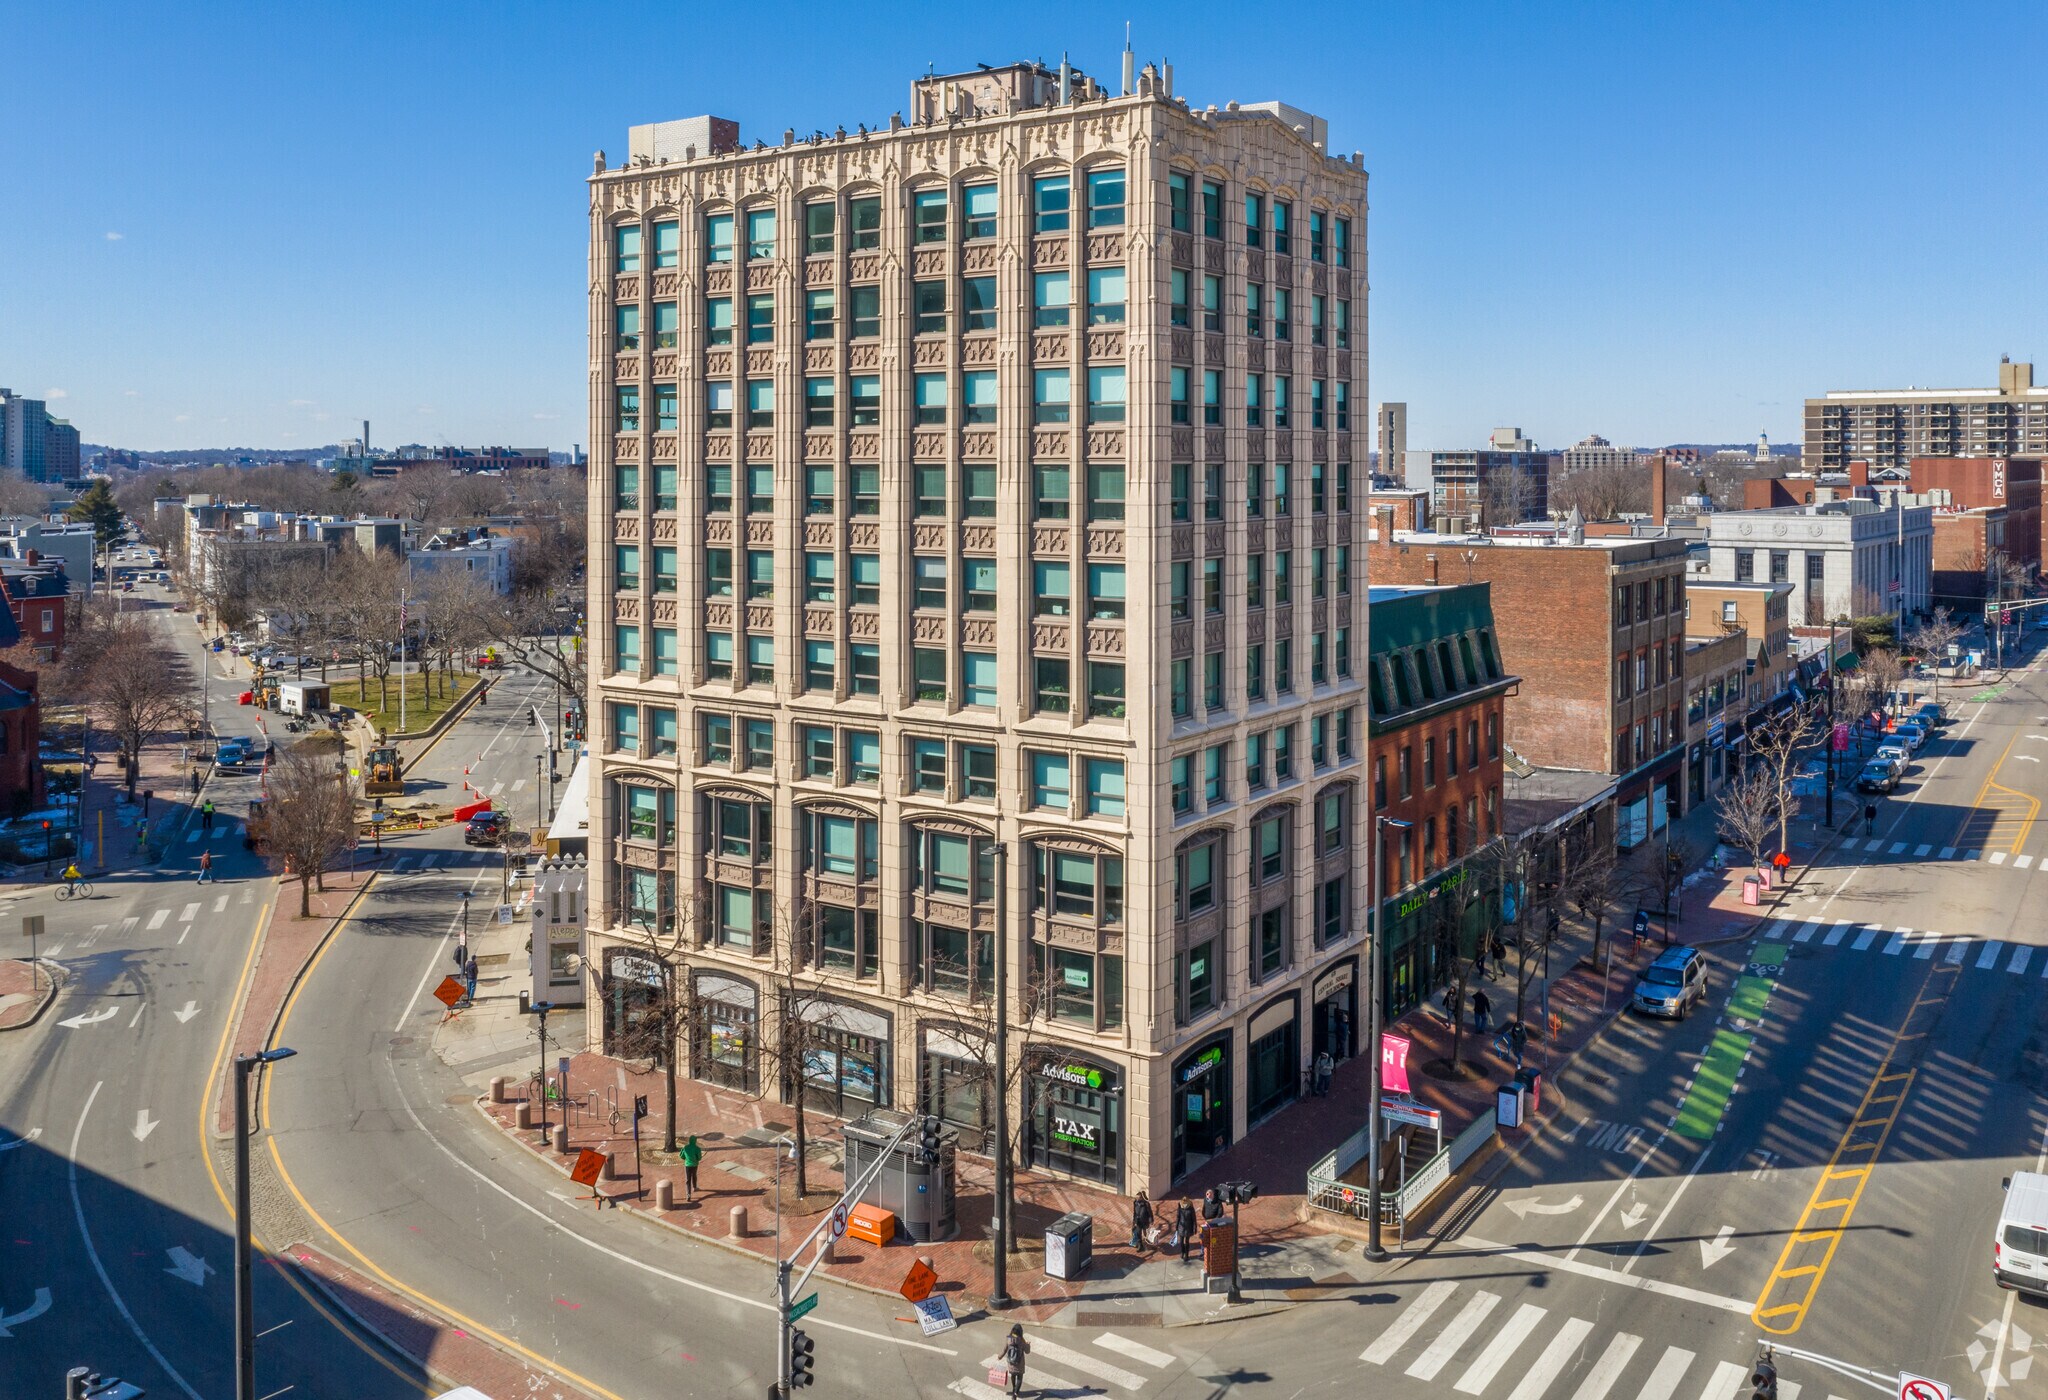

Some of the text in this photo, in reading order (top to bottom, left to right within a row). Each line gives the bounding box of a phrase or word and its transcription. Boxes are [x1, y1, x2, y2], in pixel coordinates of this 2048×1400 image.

[1994, 462, 2003, 496] YMCA
[1400, 869, 1468, 918] DAILY TABLE
[550, 927, 580, 939] Aleppo
[1317, 972, 1349, 996] CENTRAL SQUARE
[1383, 1048, 1405, 1069] Hi
[1041, 1063, 1087, 1085] Advisors
[1187, 1059, 1213, 1081] Advisors
[1392, 1103, 1414, 1113] CENTRAL
[1054, 1132, 1096, 1148] PREPARATION
[1055, 1117, 1095, 1141] TAX
[924, 1319, 954, 1334] FULL LANE
